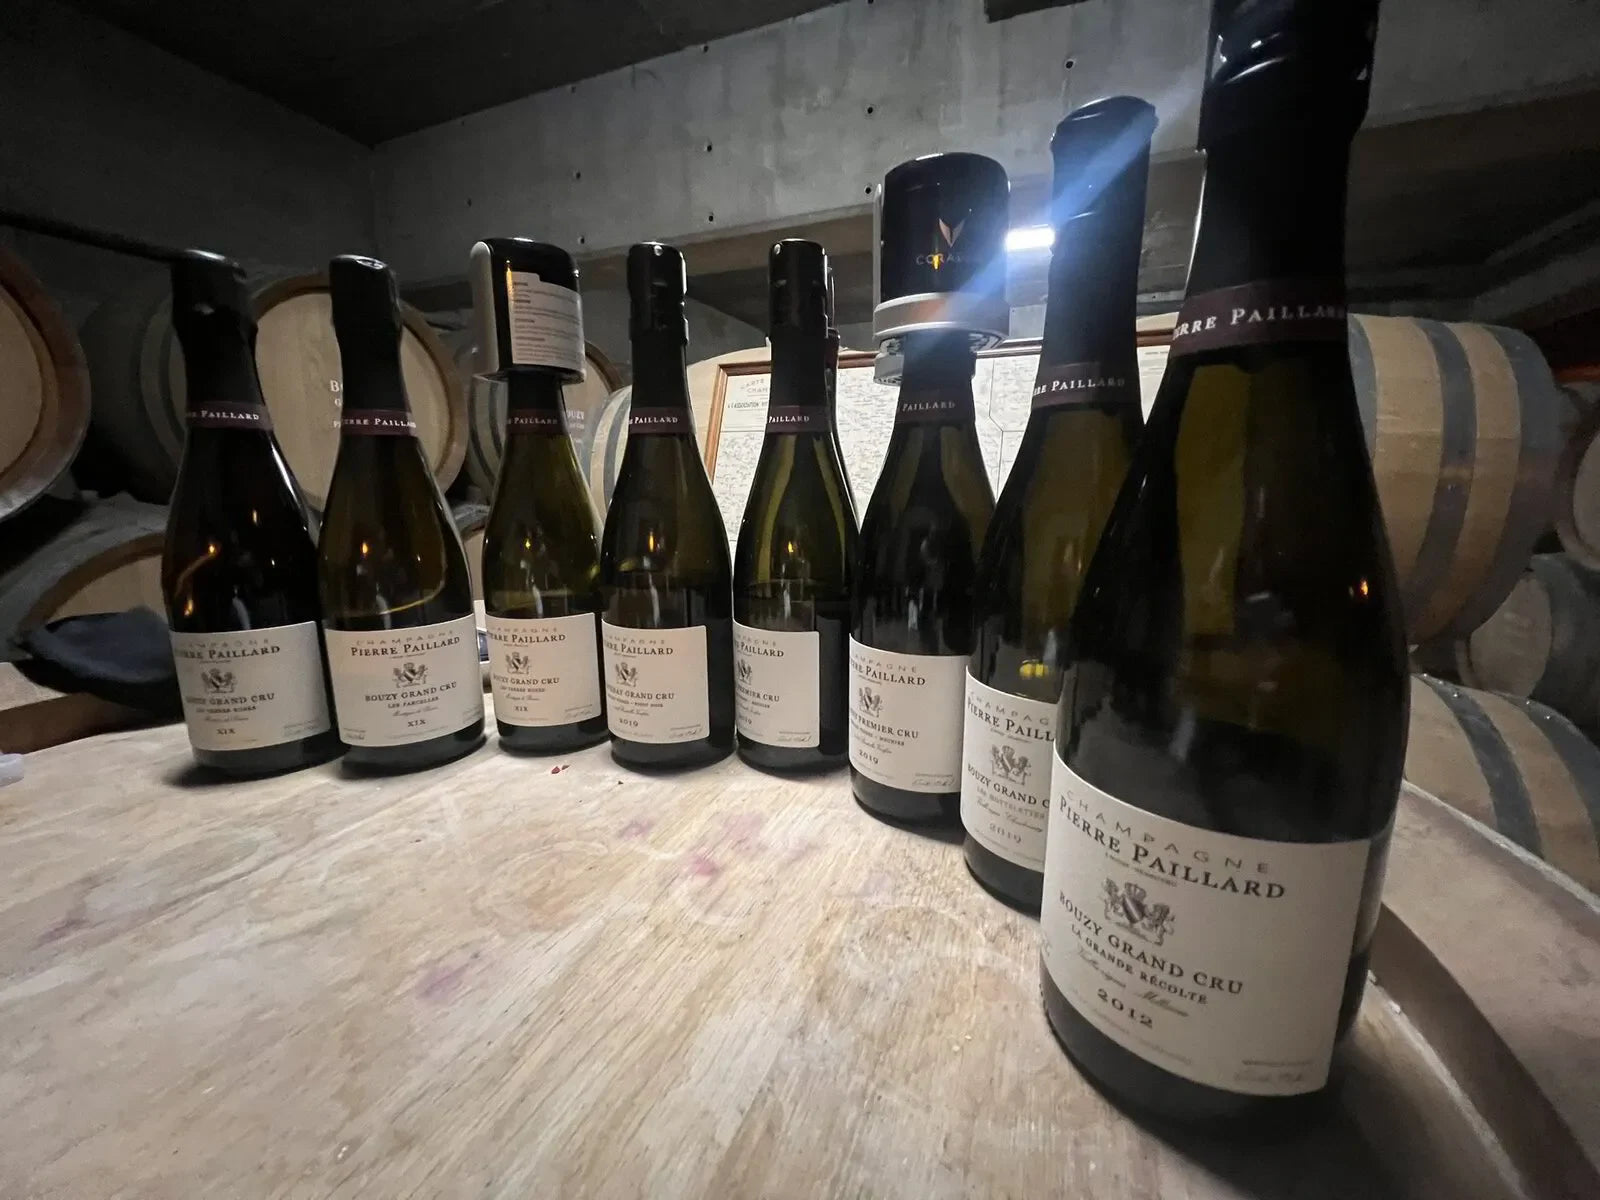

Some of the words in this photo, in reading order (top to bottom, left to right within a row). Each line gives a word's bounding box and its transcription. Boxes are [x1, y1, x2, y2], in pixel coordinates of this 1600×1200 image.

[201, 410, 259, 420] PAILLARD
[902, 401, 956, 412] PAILLARD
[634, 416, 678, 424] PAILLARD
[769, 415, 810, 424] PAILLARD
[351, 647, 399, 657] PIERRE
[404, 636, 460, 653] PAILLARD
[512, 634, 566, 643] PAILLARD
[209, 646, 280, 659] PAILLARD
[621, 643, 674, 655] PAILLARD
[740, 642, 784, 657] PAILLARD
[866, 665, 925, 686] PAILLARD
[209, 696, 247, 705] GRAND
[250, 693, 275, 703] CRU
[365, 692, 398, 702] BOUZY
[401, 687, 437, 699] GRAND
[440, 681, 457, 691] CRU
[625, 691, 653, 700] GRAND
[763, 694, 780, 702] CRU
[971, 691, 1050, 726] CHAMPAG
[407, 719, 426, 727] XIX
[858, 715, 894, 735] PREMIER
[897, 729, 919, 739] CRU
[968, 697, 1000, 727] PIERRE
[1006, 718, 1054, 742] PAILL
[859, 748, 879, 764] 2019
[968, 763, 991, 788] BOUZY
[993, 782, 1037, 805] GRAND
[989, 823, 1021, 844] 2019
[1067, 791, 1269, 874] CHAMPAGNE
[1060, 795, 1120, 853] PIERRE
[1132, 844, 1285, 899] PAILLARD
[1060, 893, 1102, 936] BOUZY
[1108, 934, 1184, 978] GRAND
[1193, 972, 1243, 995] CRU
[1071, 924, 1082, 939] LA
[1086, 937, 1133, 974] GRANDE
[1140, 972, 1207, 1004] RÉCOLTE
[1097, 988, 1153, 1029] 2012
